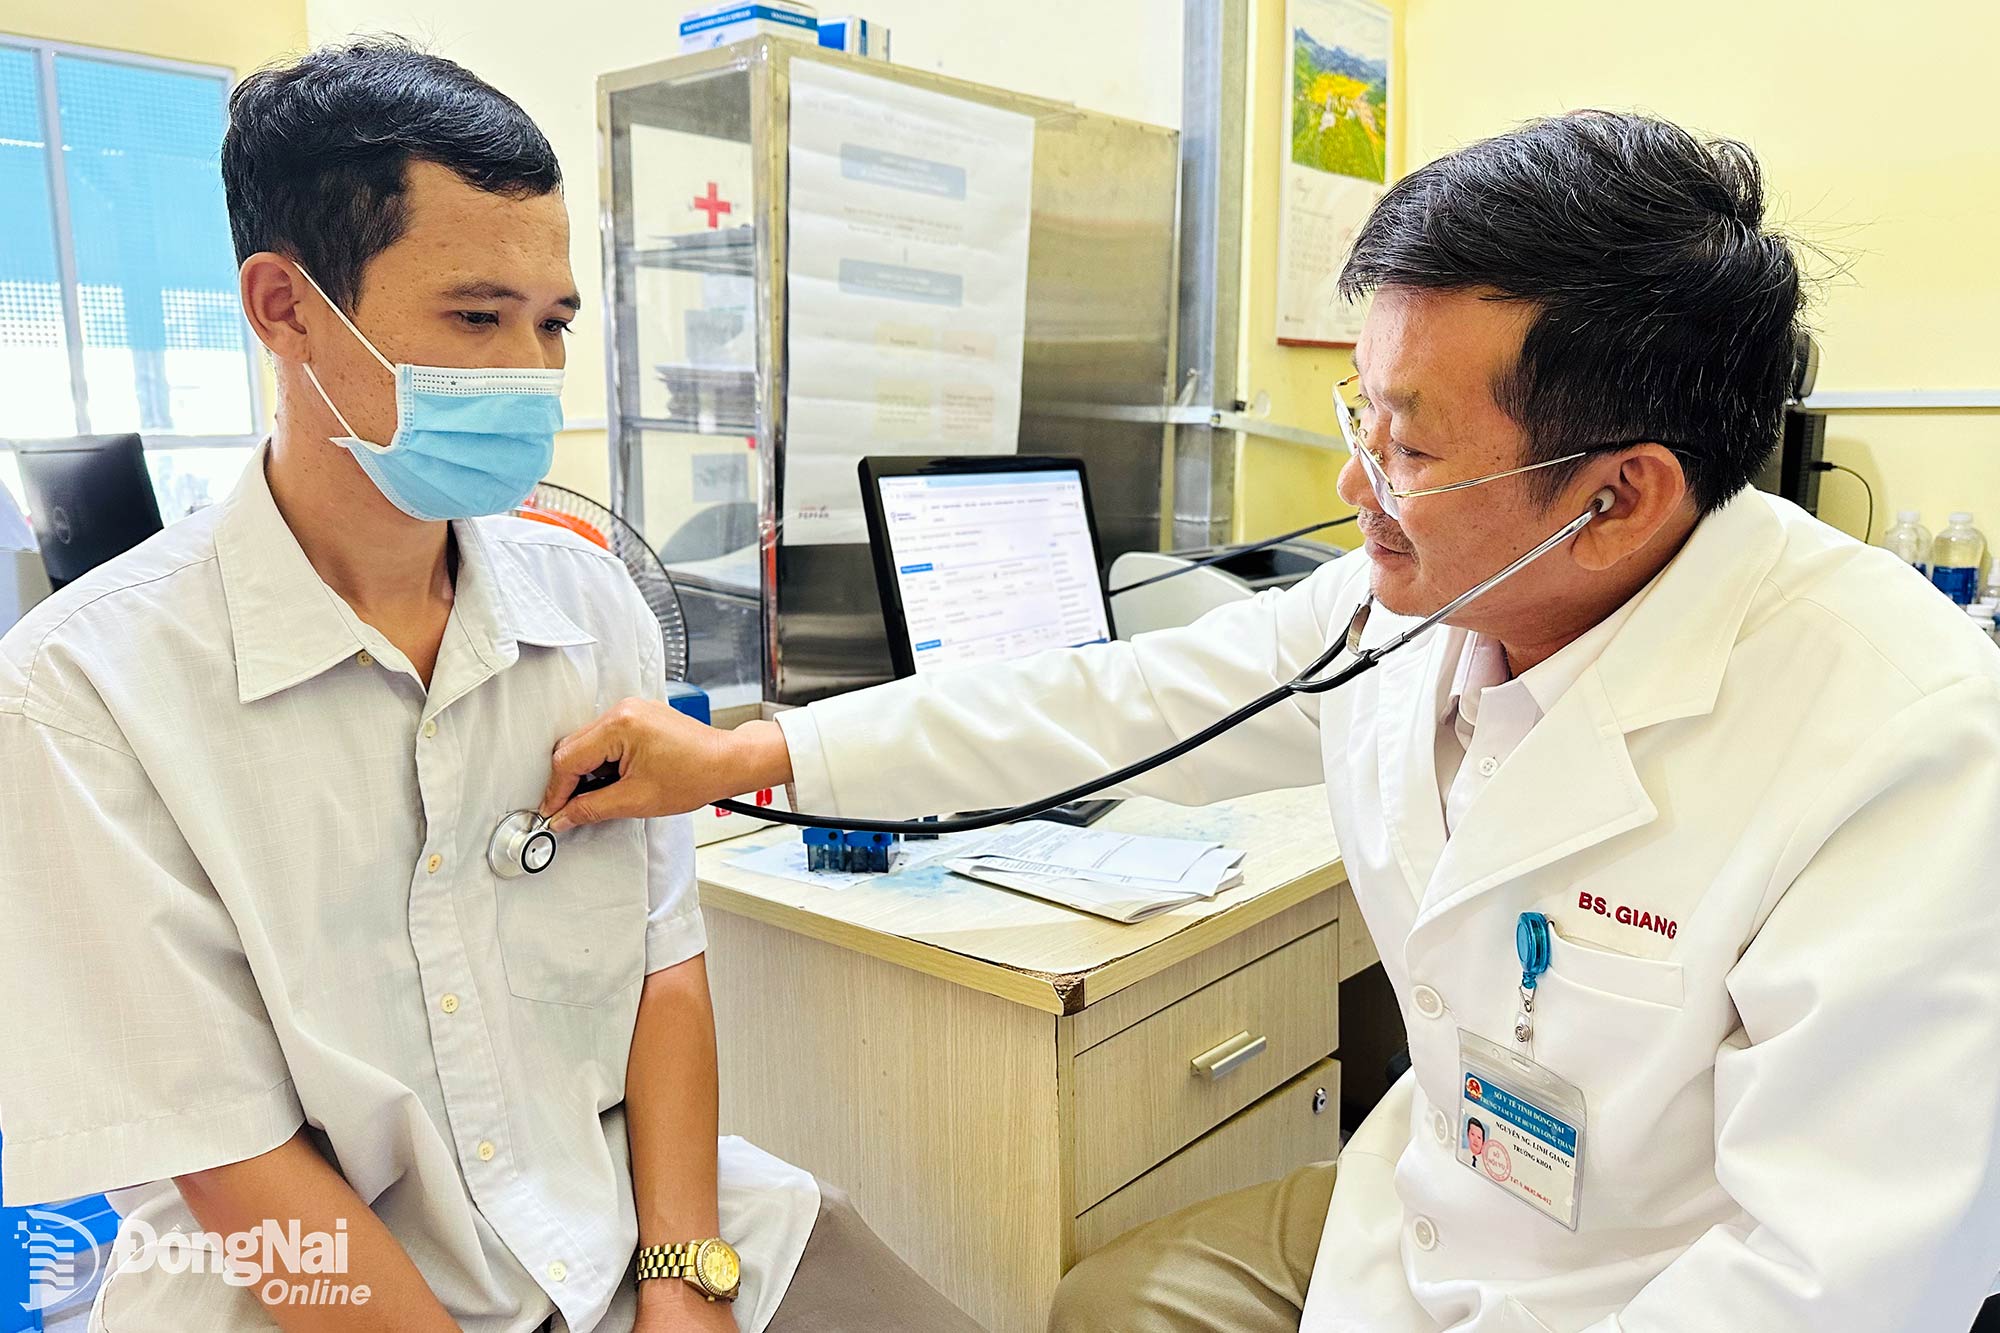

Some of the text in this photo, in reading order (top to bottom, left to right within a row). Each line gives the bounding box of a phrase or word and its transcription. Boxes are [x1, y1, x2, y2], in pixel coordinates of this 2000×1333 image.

[1578, 891, 1678, 940] BS. GIANG
[1548, 1151, 1570, 1168] GIANG
